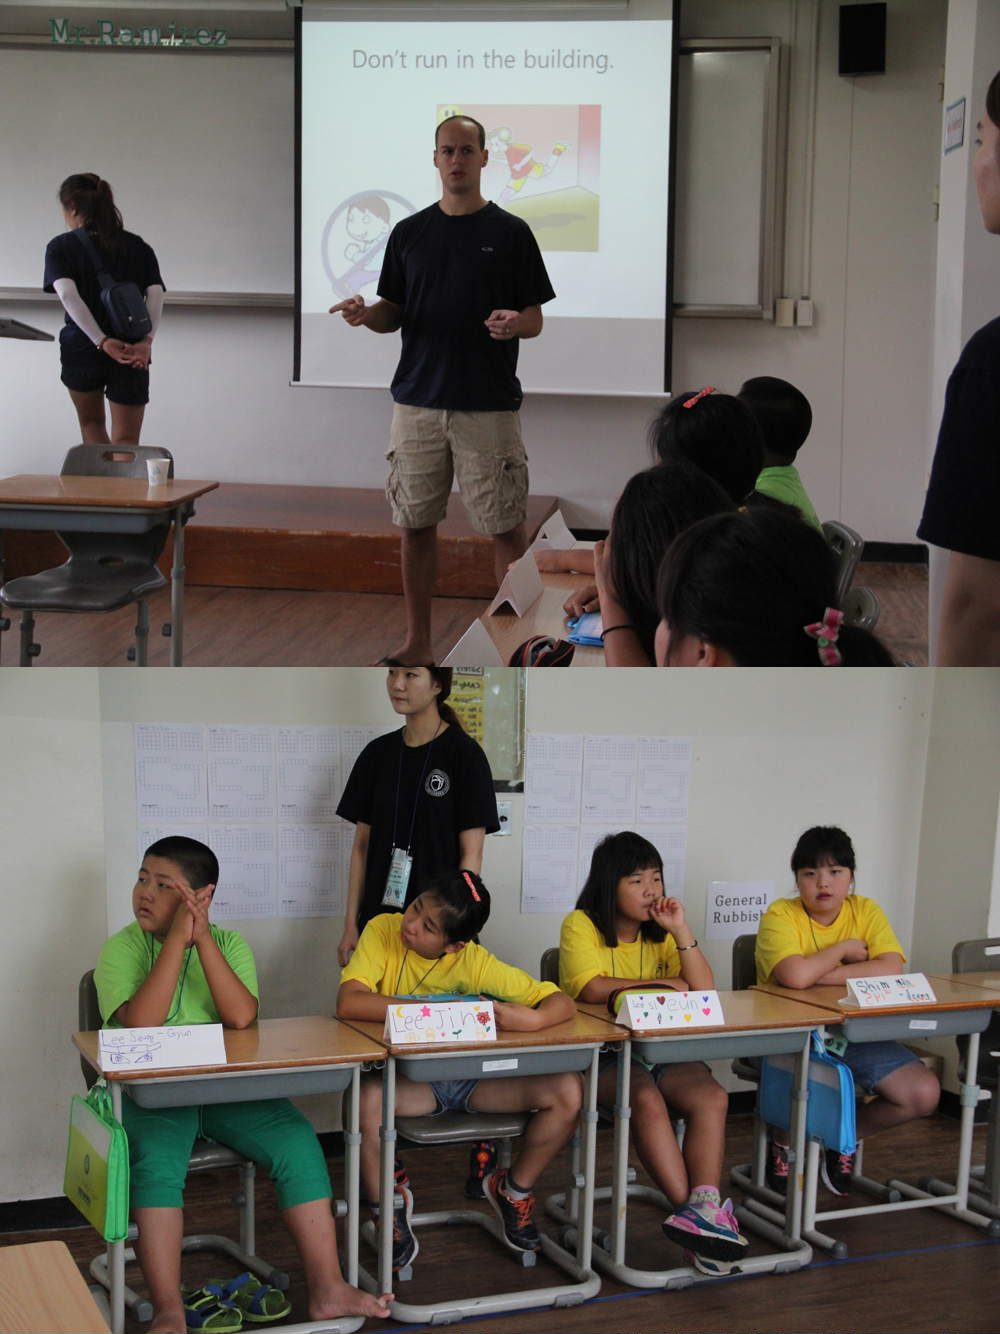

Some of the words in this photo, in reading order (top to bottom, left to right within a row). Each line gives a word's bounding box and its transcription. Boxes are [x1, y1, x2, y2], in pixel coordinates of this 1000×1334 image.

[353, 49, 407, 69] Don't
[415, 54, 448, 69] run
[456, 49, 474, 69] in
[483, 49, 516, 69] the
[524, 49, 614, 74] building.
[715, 893, 767, 907] General
[856, 980, 890, 994] Shim
[391, 1011, 425, 1033] Lee
[434, 1006, 477, 1030] Jin
[101, 1031, 126, 1046] Lee
